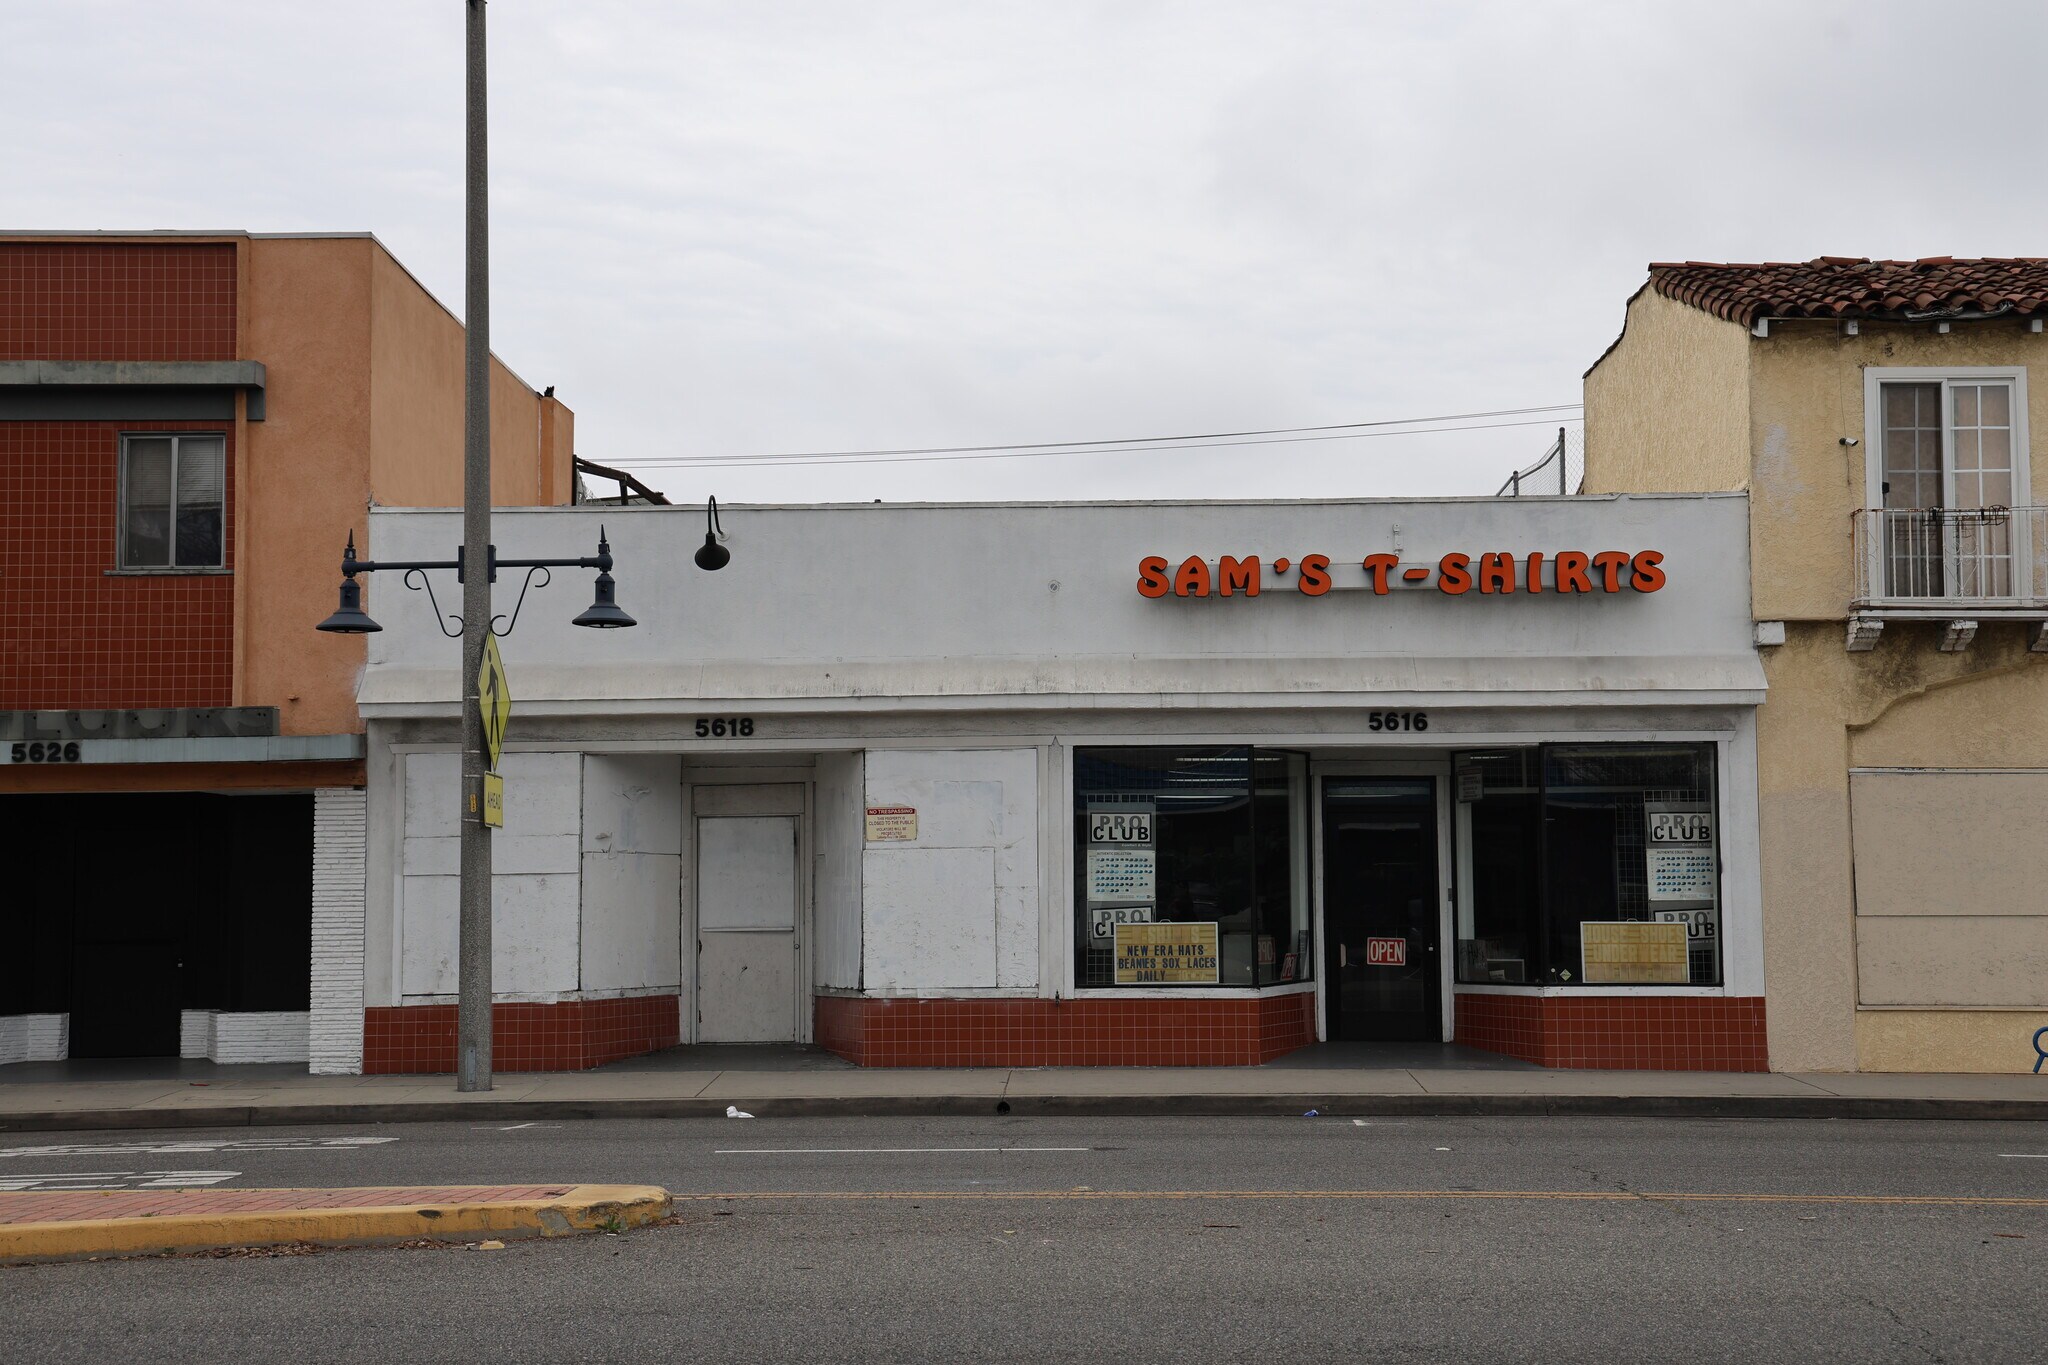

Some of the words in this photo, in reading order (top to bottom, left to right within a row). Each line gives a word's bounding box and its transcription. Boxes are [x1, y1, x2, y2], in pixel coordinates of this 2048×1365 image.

[1136, 553, 1333, 599] SAM'S
[1362, 550, 1667, 596] T-SHIRTS
[695, 718, 754, 737] 5618
[1368, 711, 1428, 731] 5616
[11, 742, 80, 762] 5626
[487, 791, 501, 810] AHEAD
[1100, 815, 1143, 829] PRO
[1659, 815, 1704, 829] PRO
[1093, 826, 1149, 841] CLUB
[1653, 826, 1711, 840] CLUB
[1101, 909, 1143, 923] PRO
[1127, 945, 1148, 956] NEW
[1154, 944, 1173, 955] ERA
[1178, 944, 1204, 955] HATS
[1370, 941, 1402, 961] OPEN
[1118, 958, 1156, 969] BEANIES
[1162, 957, 1180, 969] SOX
[1187, 957, 1216, 968] LACES
[1137, 970, 1165, 982] DAILY
